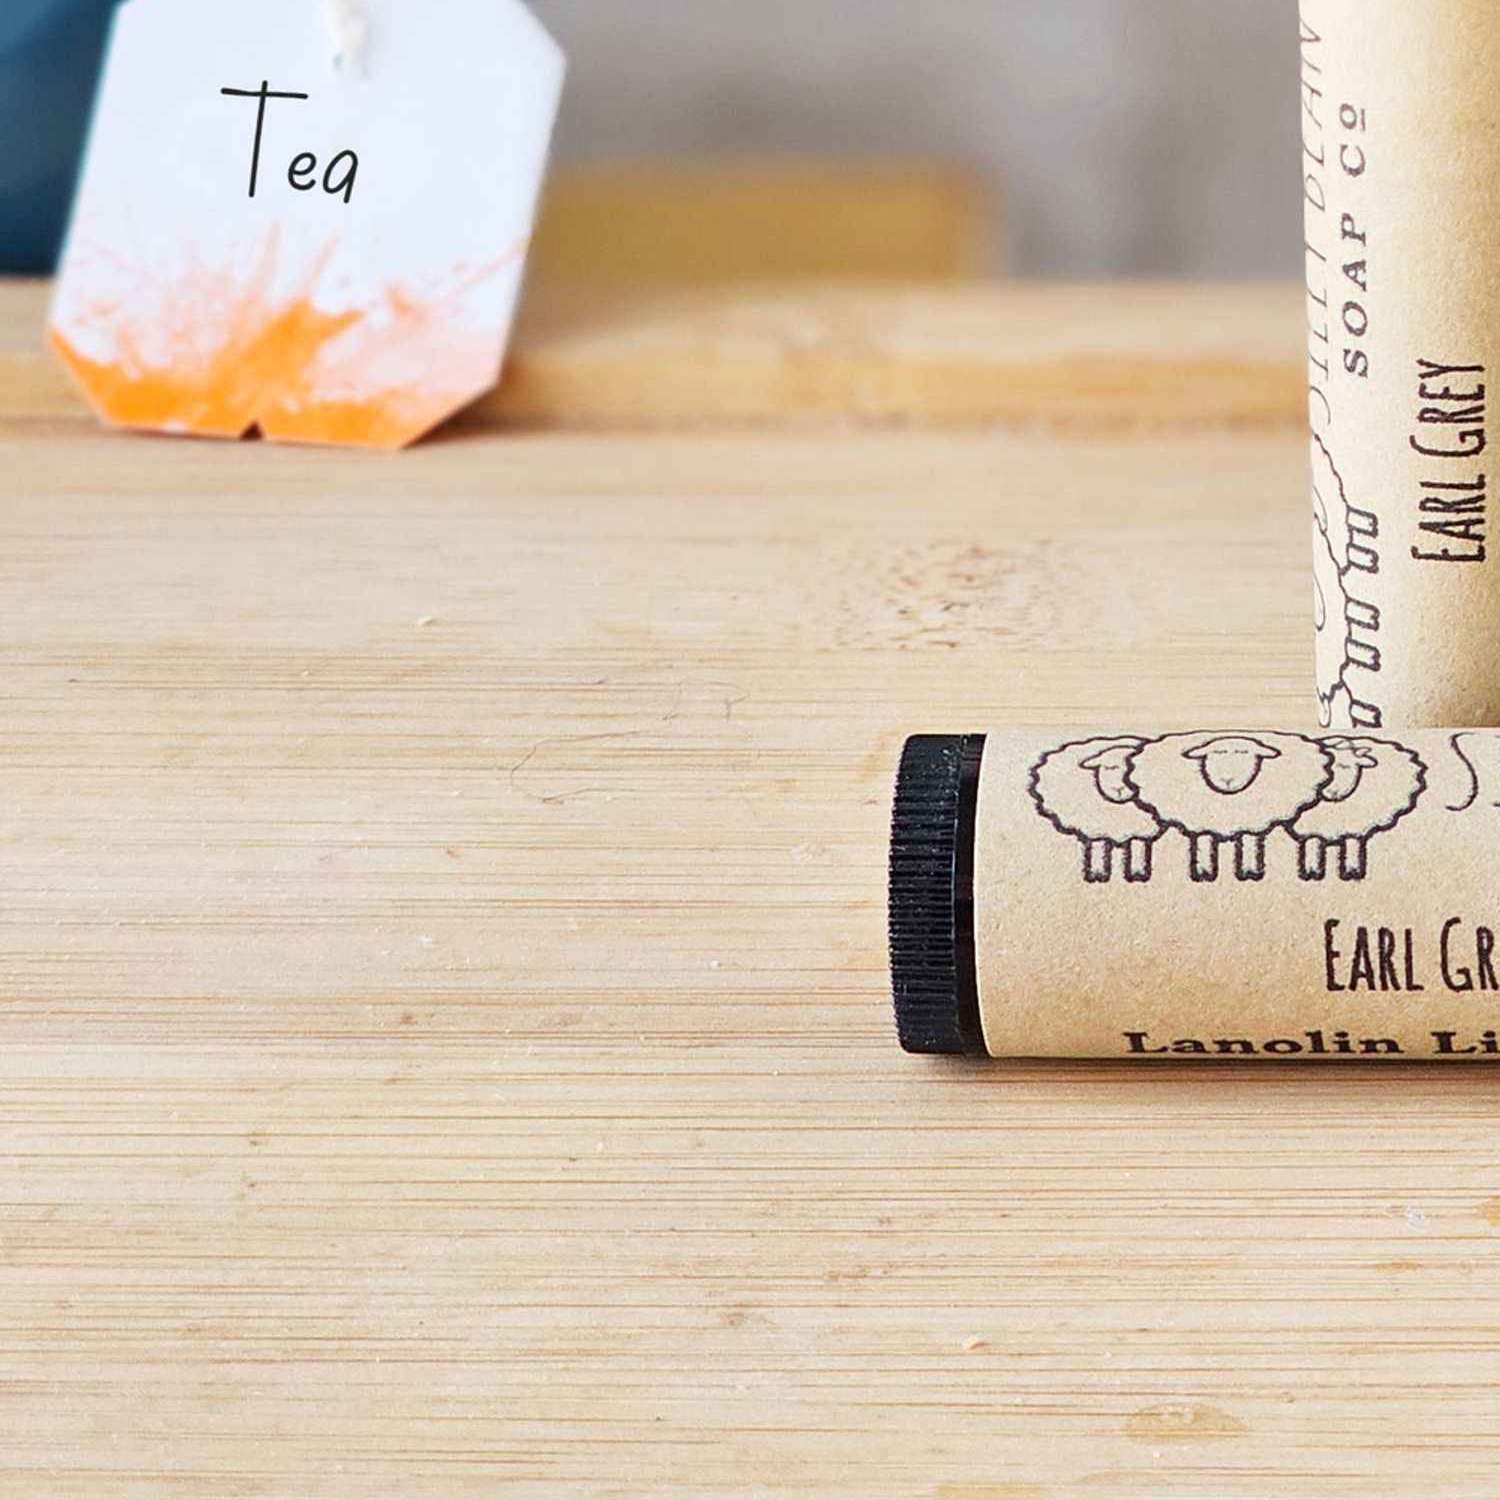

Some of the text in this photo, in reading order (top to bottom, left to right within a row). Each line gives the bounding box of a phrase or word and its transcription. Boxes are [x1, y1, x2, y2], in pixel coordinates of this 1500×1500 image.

[220, 80, 359, 204] Tea
[1340, 212, 1369, 379] SOAP
[1409, 357, 1487, 564] EARL GREY
[1324, 917, 1425, 992] EARL
[1122, 1029, 1405, 1055] Lanolin
